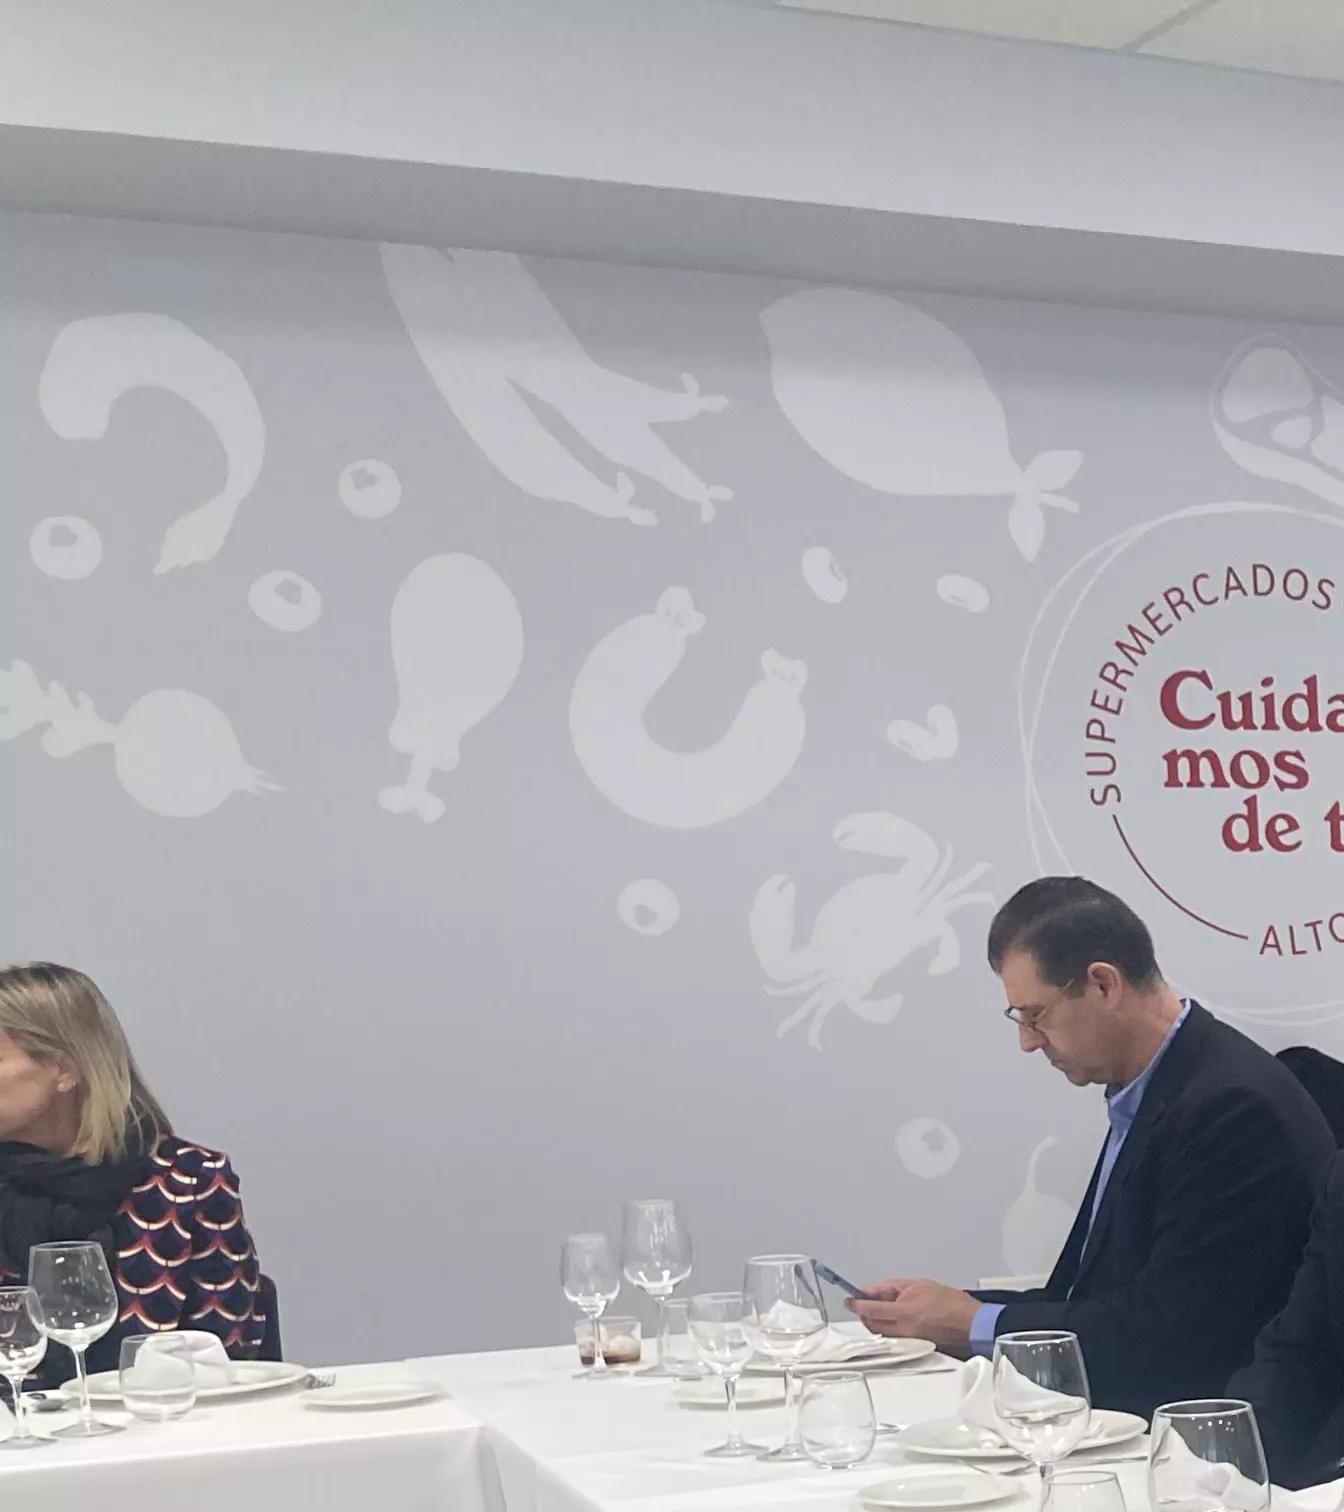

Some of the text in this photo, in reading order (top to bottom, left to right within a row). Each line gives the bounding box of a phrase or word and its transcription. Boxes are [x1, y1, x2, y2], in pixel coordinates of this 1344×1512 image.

[1085, 563, 1335, 806] SUPERMERCADOS
[1162, 747, 1310, 791] mos
[1221, 794, 1302, 853] de
